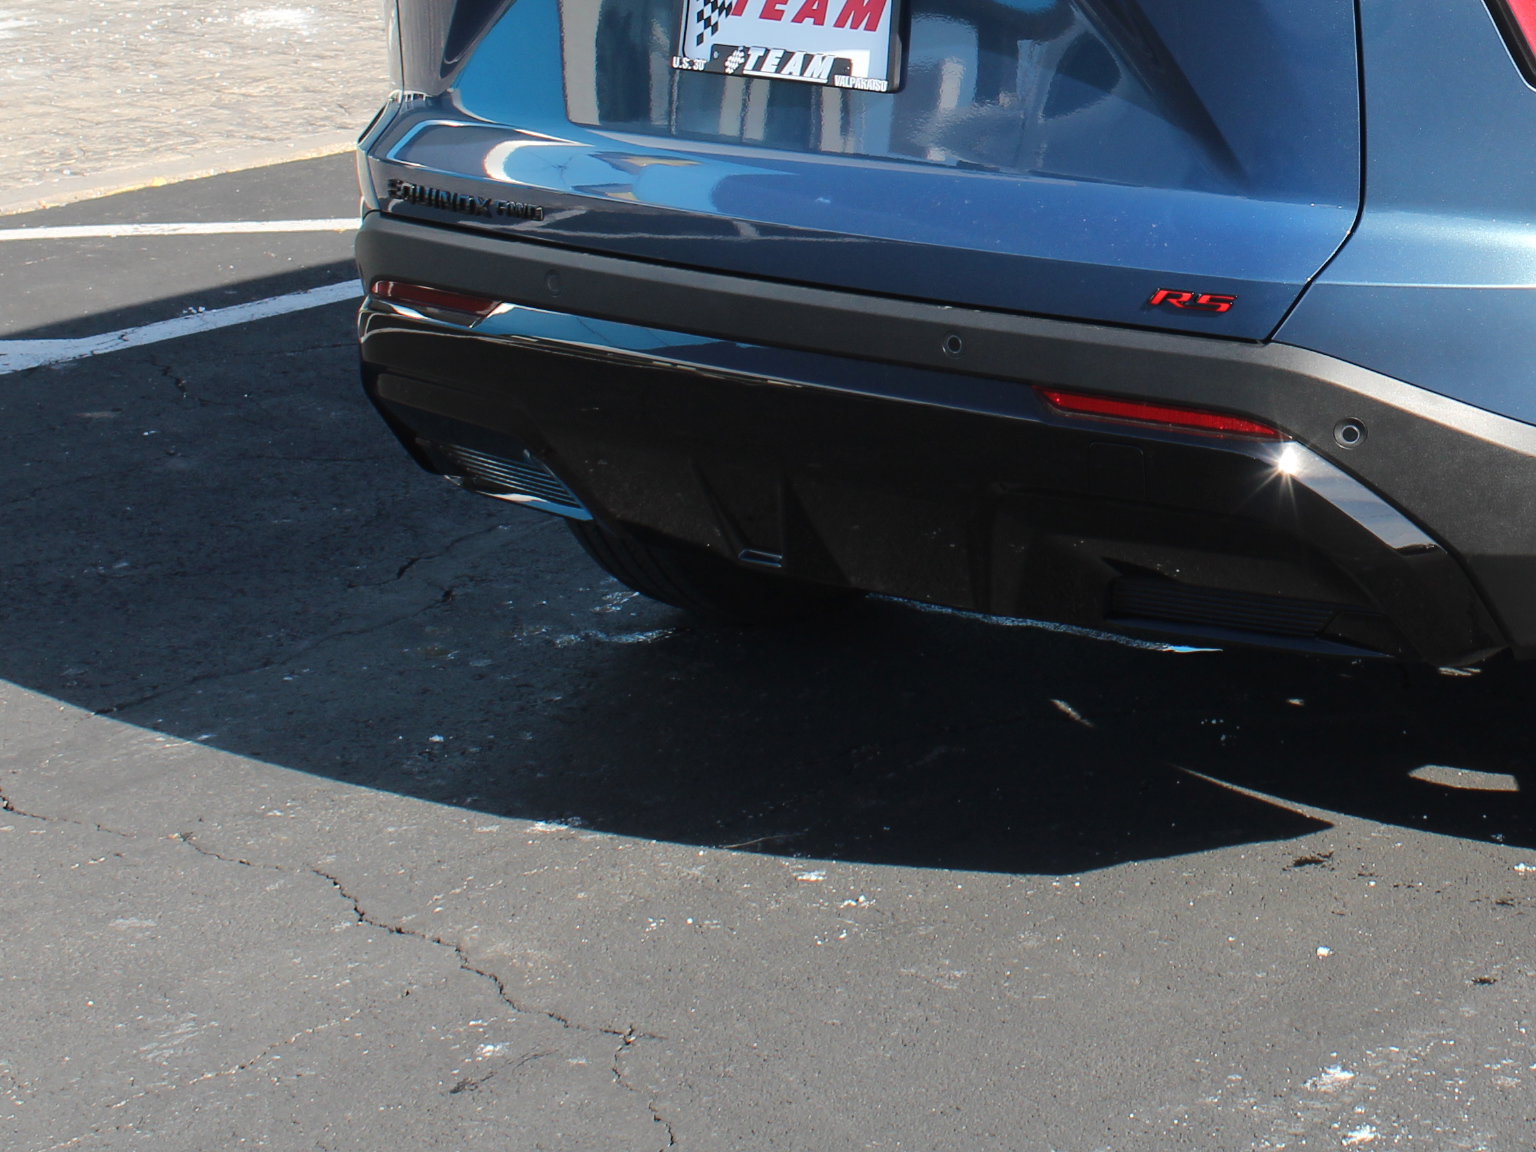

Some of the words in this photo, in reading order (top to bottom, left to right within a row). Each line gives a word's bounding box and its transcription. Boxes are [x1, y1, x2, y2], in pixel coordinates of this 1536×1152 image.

[743, 45, 837, 80] TEAM
[387, 178, 491, 218] EQUINOX
[1147, 287, 1239, 313] RS
